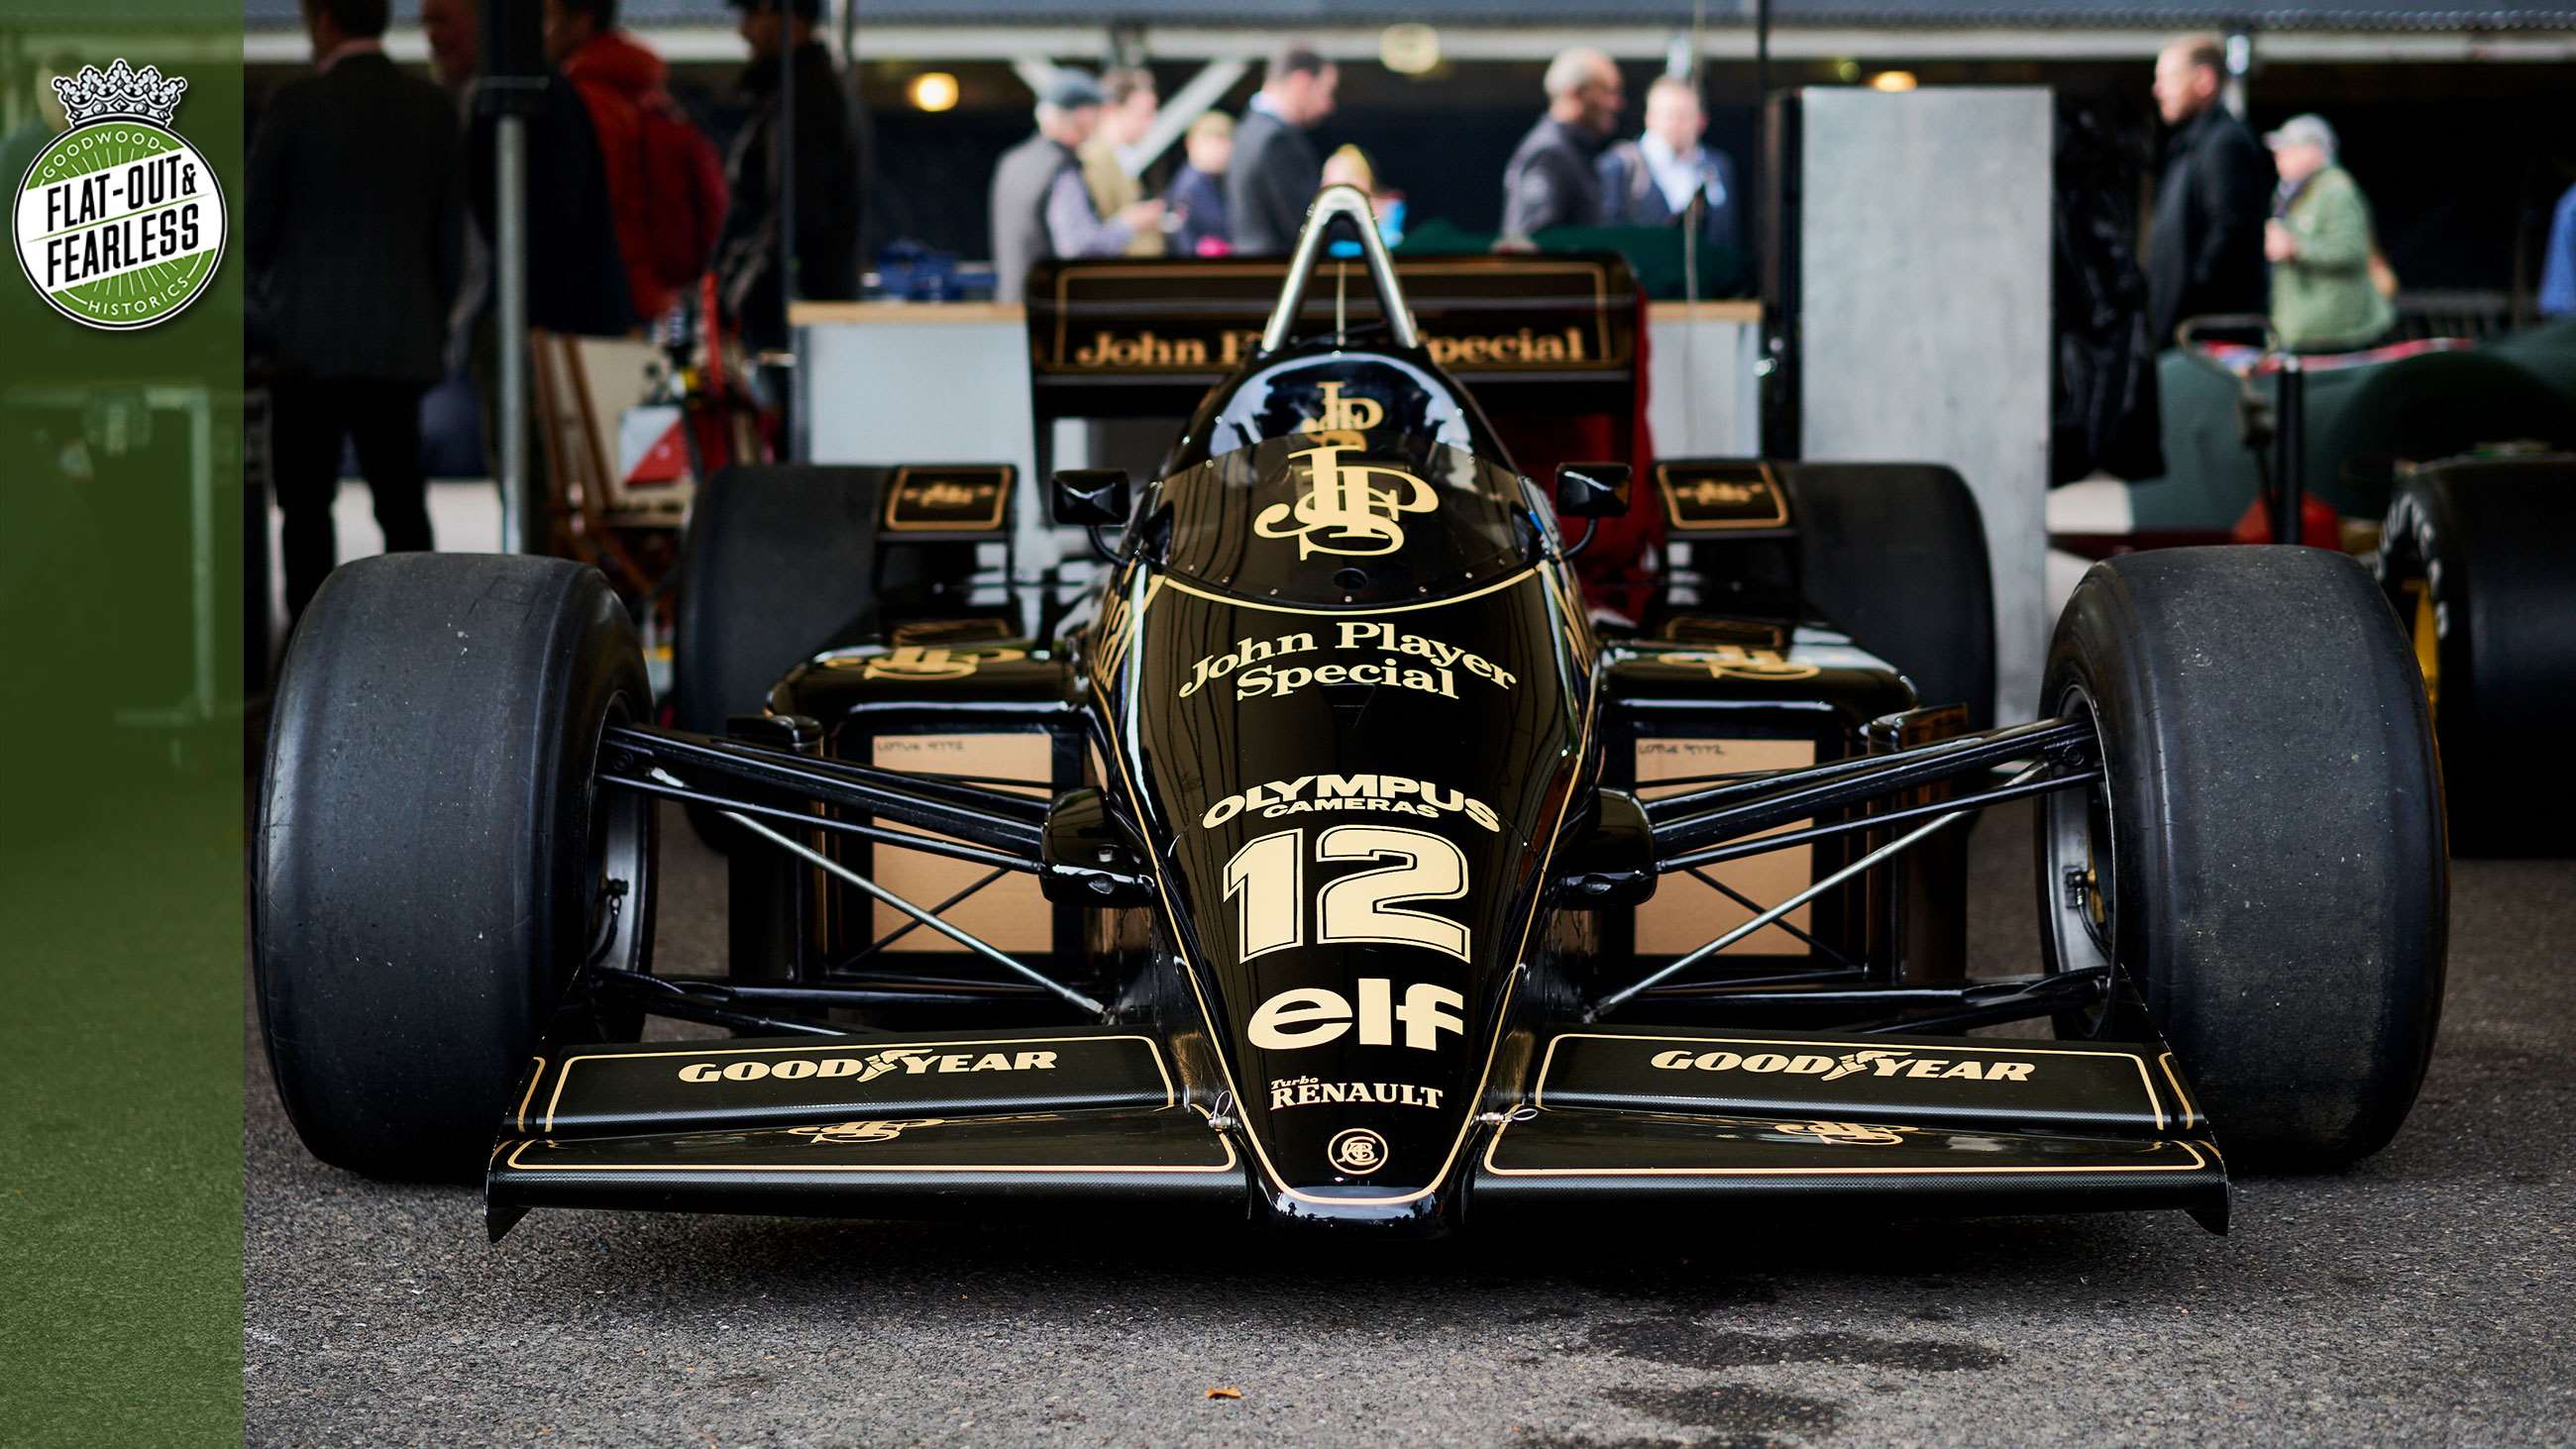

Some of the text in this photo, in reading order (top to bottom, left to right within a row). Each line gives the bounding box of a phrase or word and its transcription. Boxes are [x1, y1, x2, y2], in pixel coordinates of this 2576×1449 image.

[1077, 331, 1206, 365] John
[1421, 327, 1583, 363] pecial
[1179, 632, 1319, 697] John
[1335, 622, 1517, 689] Player
[1236, 658, 1459, 701] Special
[1203, 774, 1500, 833] OLYMPUS
[1262, 797, 1440, 819] CAMERAS
[1223, 824, 1471, 964] 12
[1247, 978, 1464, 1052] elf
[1269, 1083, 1444, 1110] RENAULT
[1270, 1076, 1319, 1089] Turbo
